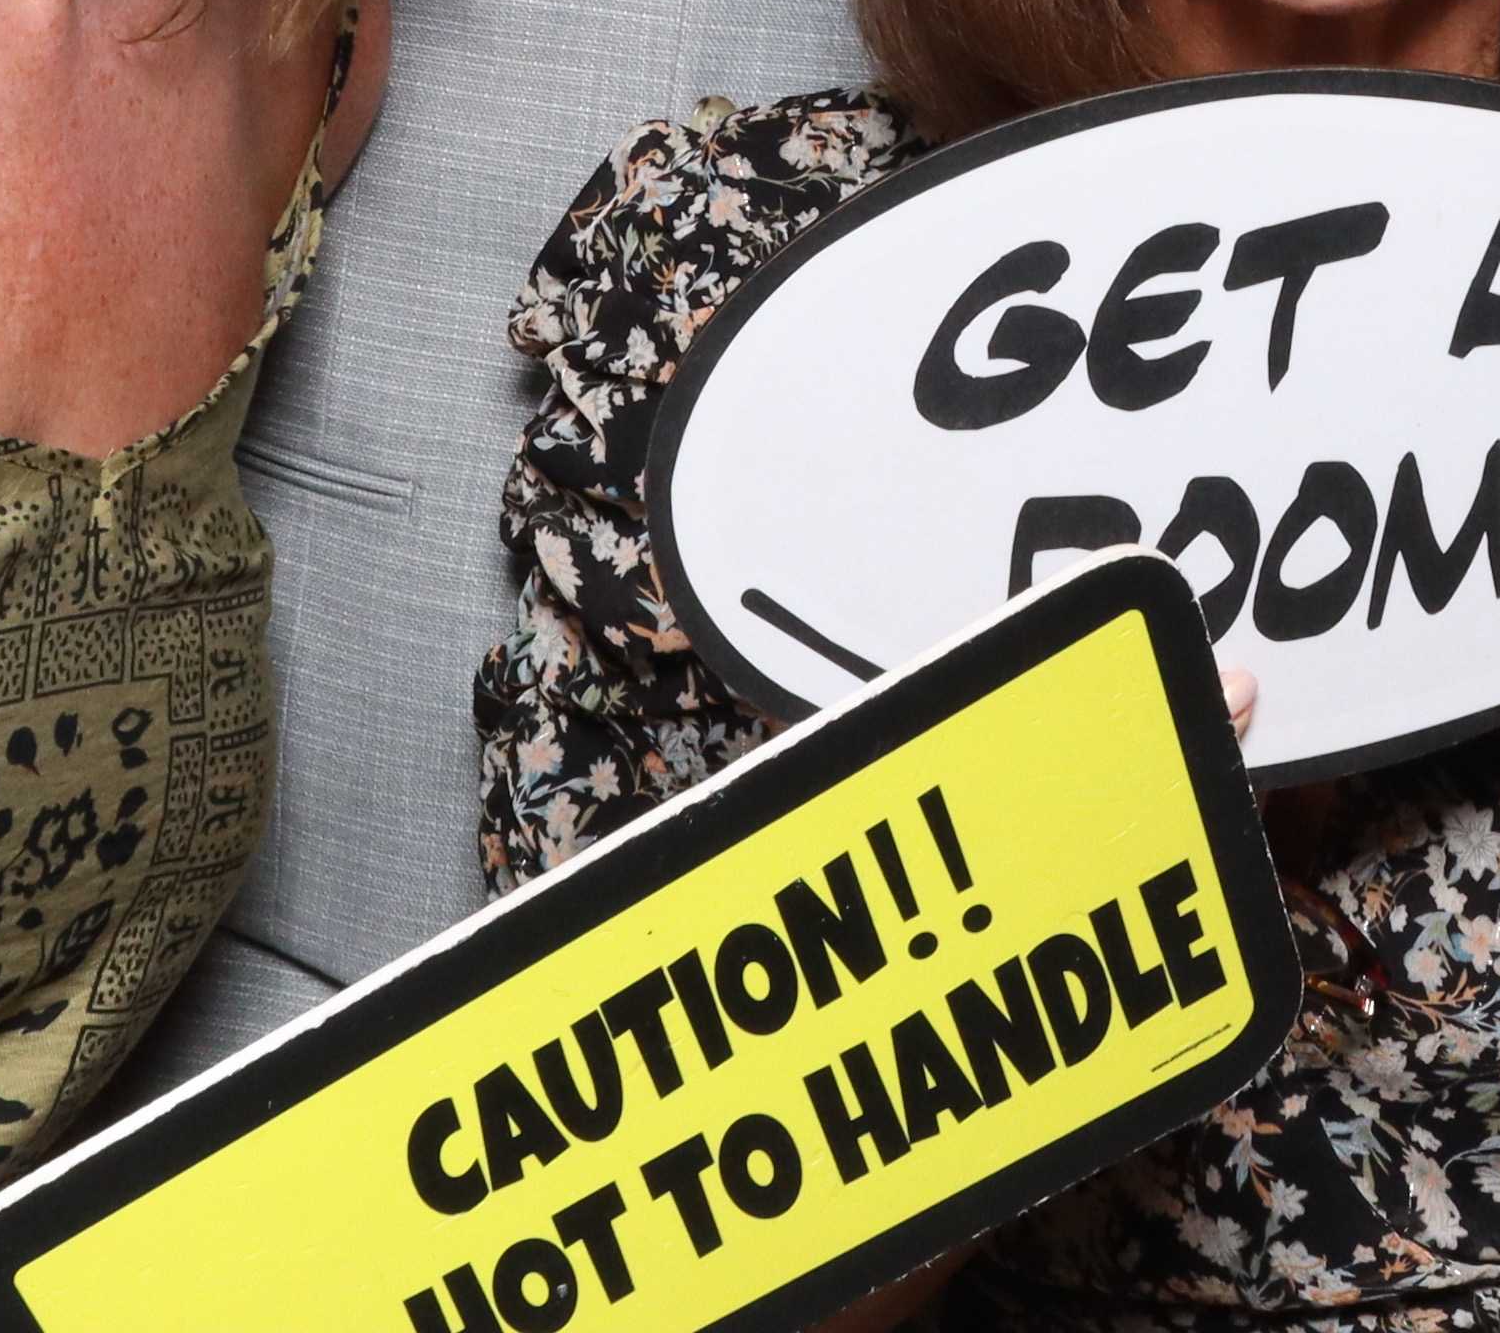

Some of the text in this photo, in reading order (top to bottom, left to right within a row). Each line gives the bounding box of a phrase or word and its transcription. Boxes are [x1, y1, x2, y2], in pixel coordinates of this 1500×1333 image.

[912, 200, 1390, 431] GET
[407, 785, 992, 1215] CAUTION!!
[640, 1113, 803, 1258] TO
[803, 858, 1229, 1185] HANDLE
